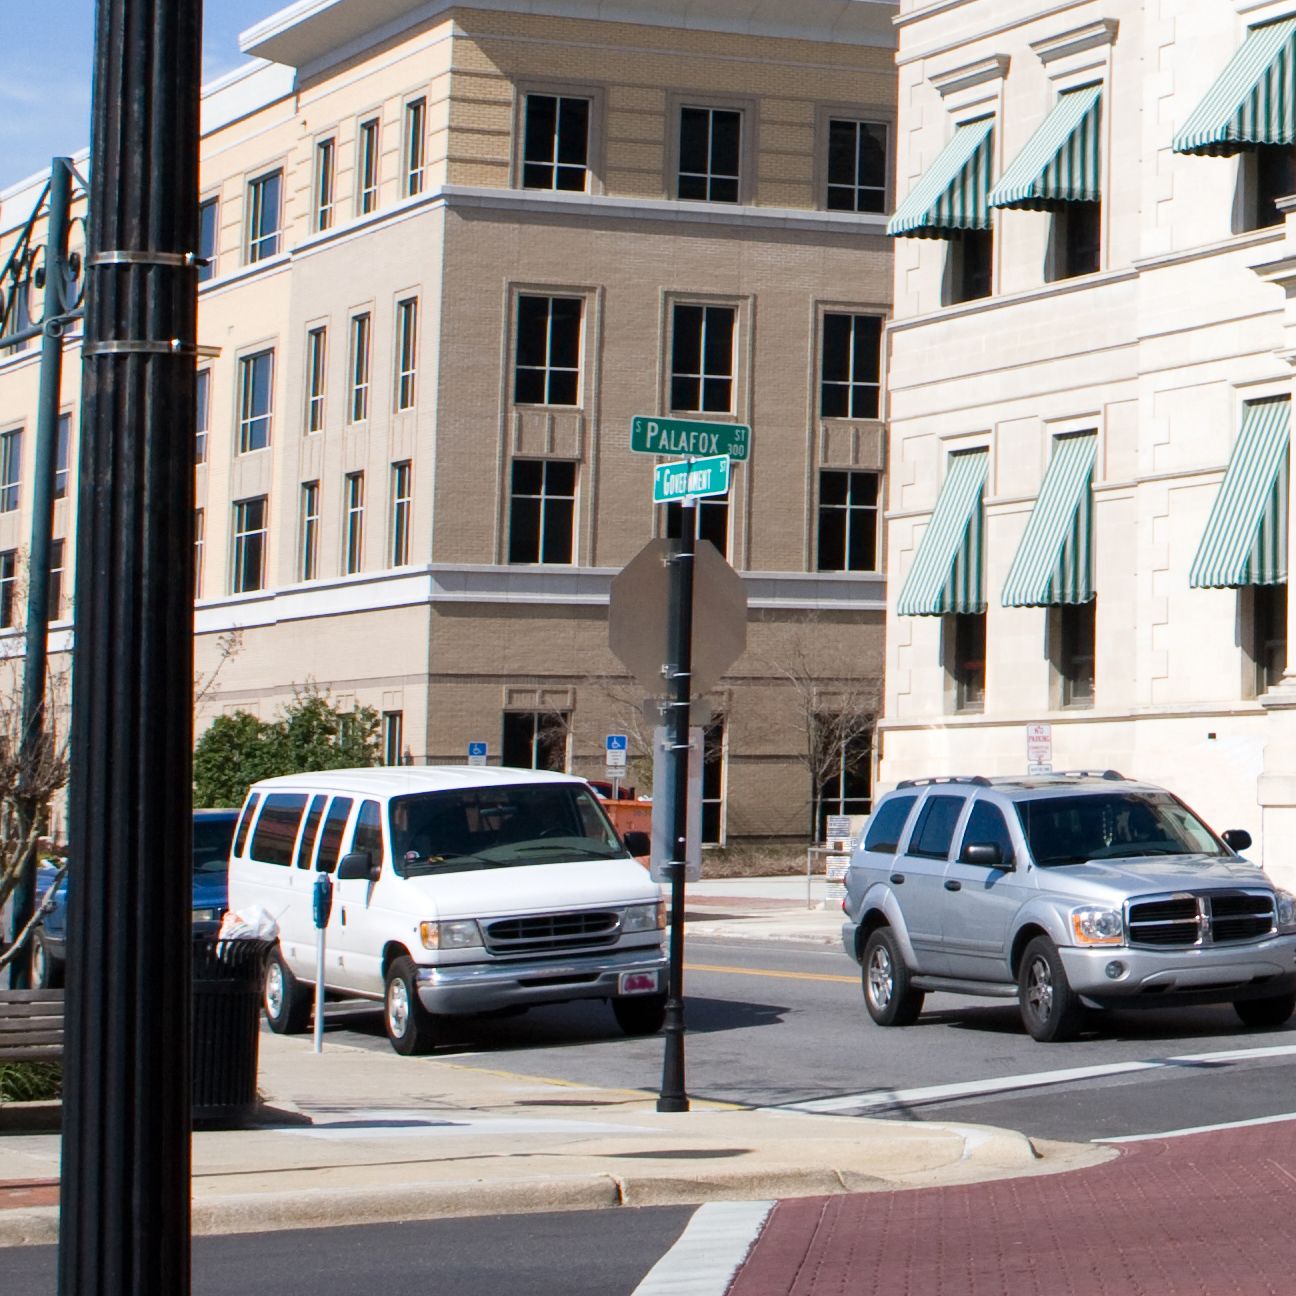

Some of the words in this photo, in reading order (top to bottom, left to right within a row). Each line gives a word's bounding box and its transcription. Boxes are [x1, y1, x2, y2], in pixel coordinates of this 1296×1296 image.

[635, 421, 642, 433] S
[646, 421, 720, 454] PALAFOX
[734, 429, 746, 442] ST
[727, 443, 745, 456] 300
